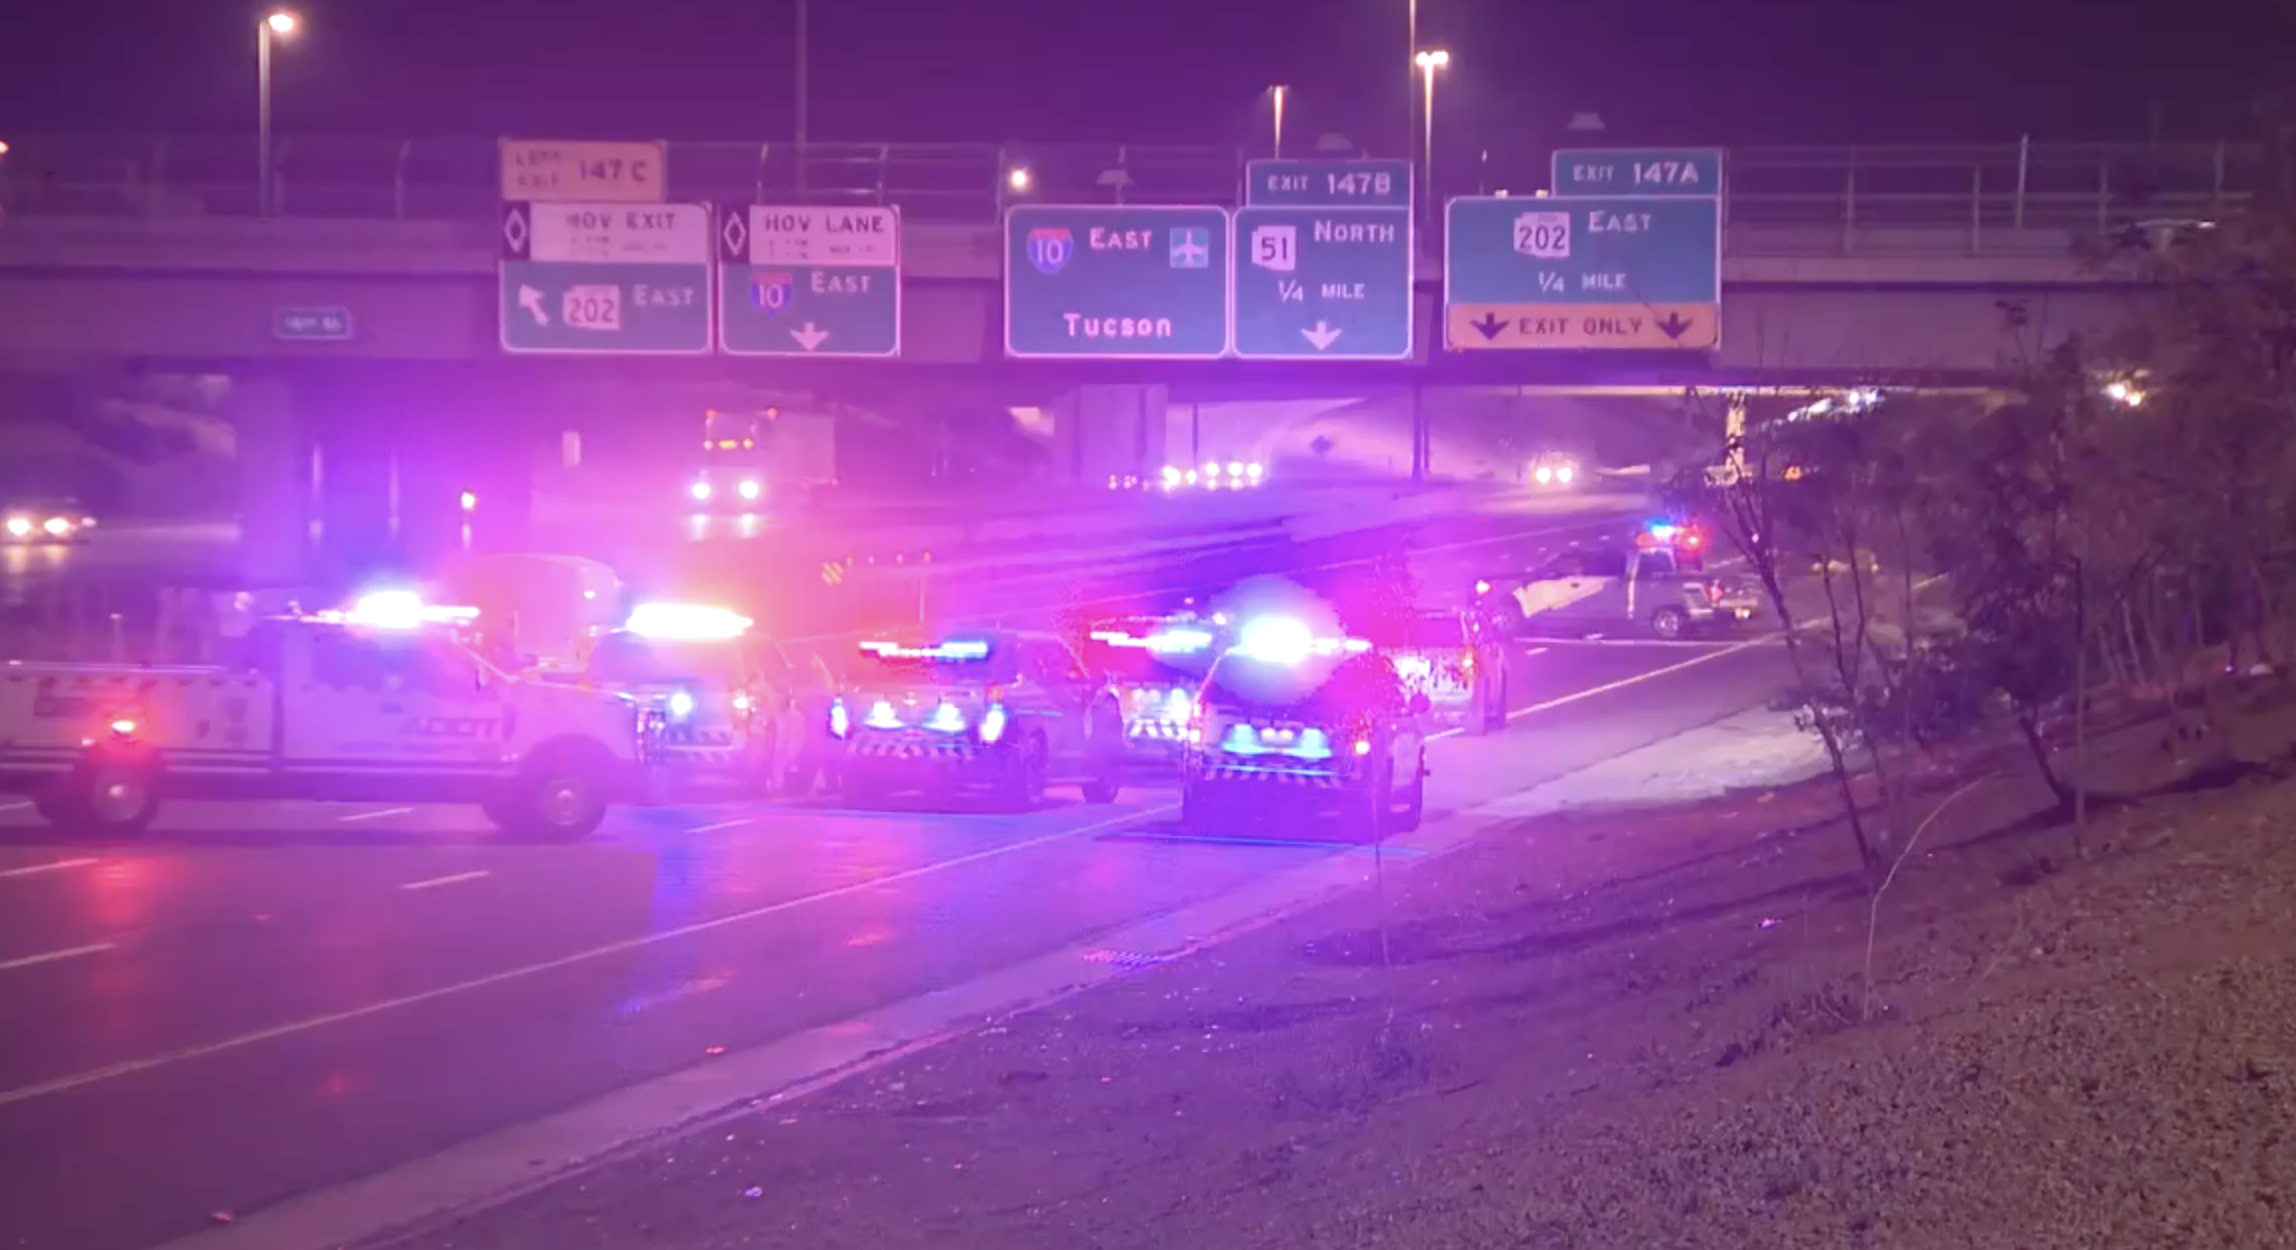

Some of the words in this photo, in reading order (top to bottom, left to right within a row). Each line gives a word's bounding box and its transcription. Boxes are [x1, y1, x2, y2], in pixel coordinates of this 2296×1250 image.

[1267, 174, 1309, 191] EXIT
[1327, 172, 1391, 195] 147B
[1573, 164, 1615, 182] EXIT
[1633, 161, 1699, 184] 147A
[566, 211, 612, 231] HOV
[626, 211, 675, 231] EXIT
[764, 214, 811, 233] HOV
[825, 214, 884, 233] LANE
[1519, 225, 1566, 251] 202
[1588, 210, 1652, 232] EAST
[1037, 239, 1063, 264] 10
[1089, 227, 1152, 249] EAST
[1261, 236, 1287, 261] 51
[1314, 220, 1395, 242] NORTH
[759, 283, 784, 309] 10
[811, 271, 871, 293] EAST
[1321, 283, 1365, 299] MILE
[1582, 273, 1627, 290] MILE
[569, 298, 615, 323] 202
[634, 284, 694, 306] EAST
[1063, 312, 1171, 337] Tucson
[1519, 317, 1569, 335] EXIT
[1583, 317, 1643, 335] ONLY
